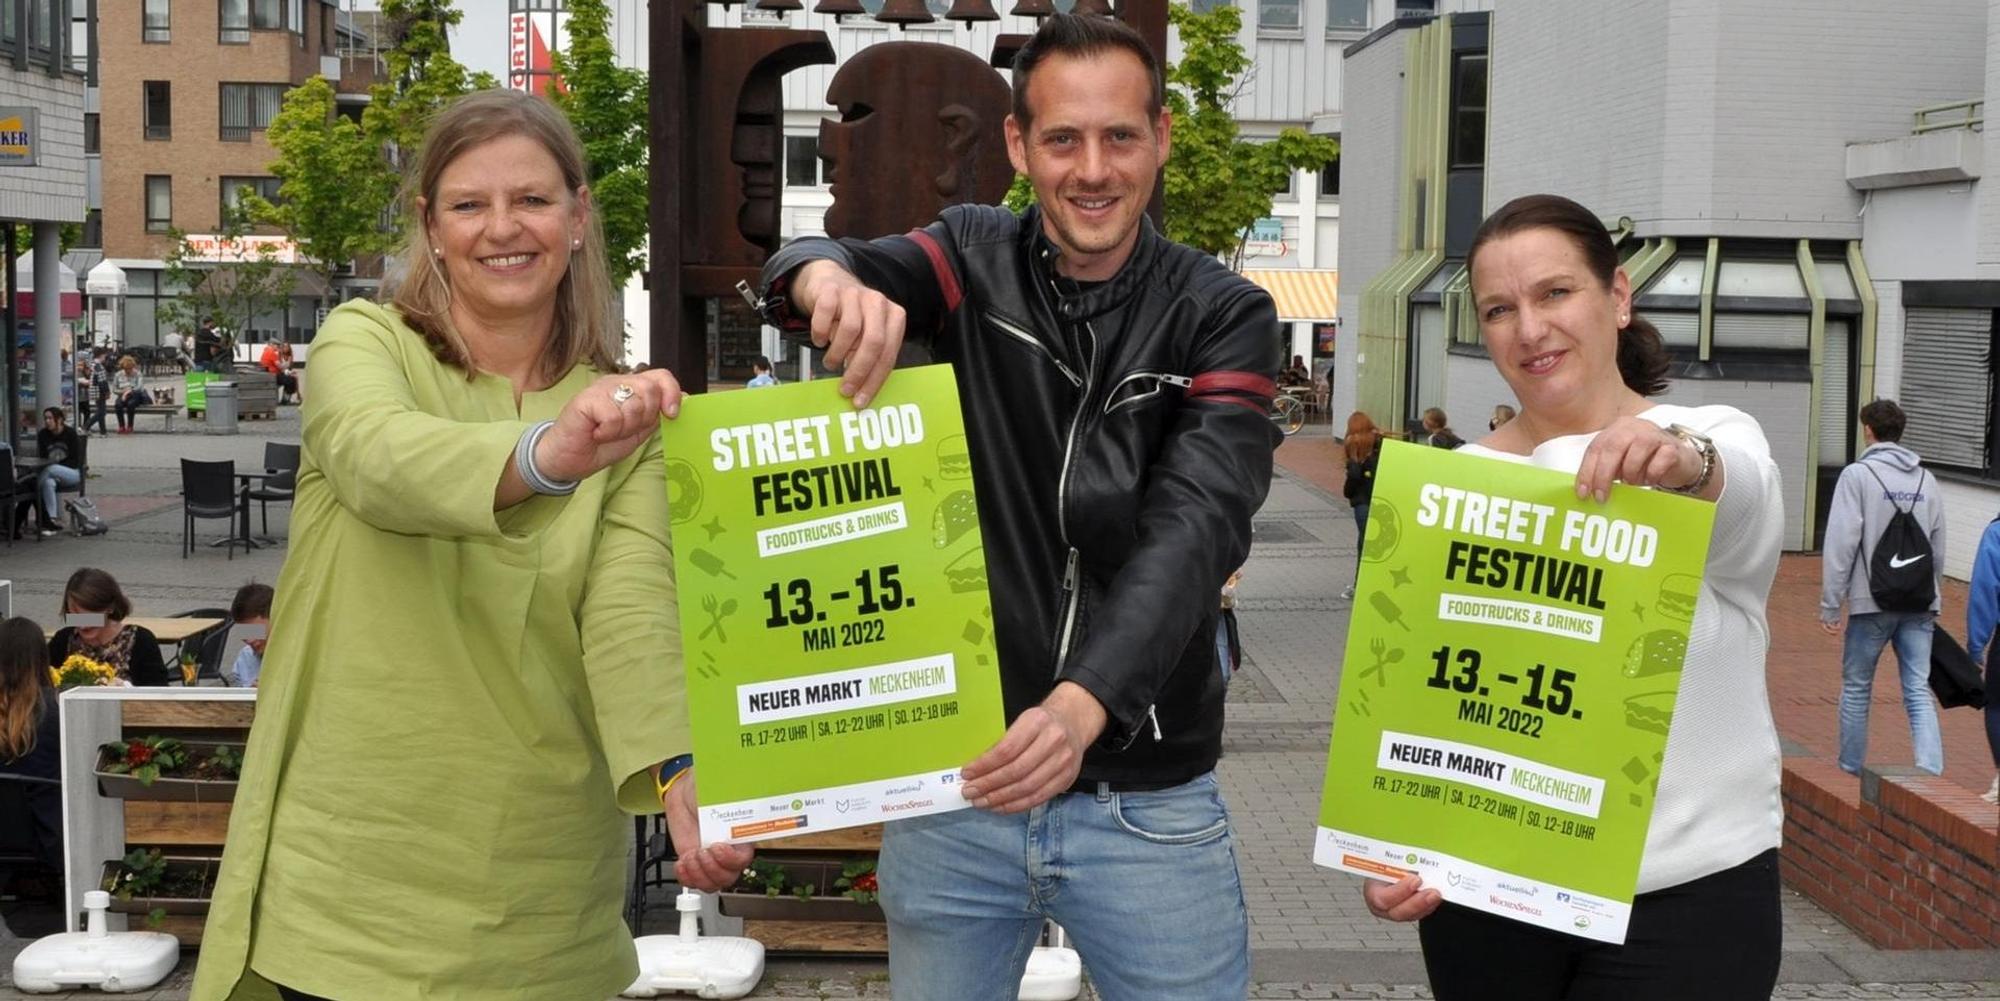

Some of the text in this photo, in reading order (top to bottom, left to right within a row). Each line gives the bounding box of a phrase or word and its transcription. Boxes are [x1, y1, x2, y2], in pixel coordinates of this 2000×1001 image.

[710, 403, 924, 471] STREET FOOD
[752, 457, 902, 517] FESTIVAL
[766, 509, 900, 550] FOODTRUCKS & DRINKS
[1417, 483, 1658, 568] STREET FOOD
[1445, 540, 1606, 610] FESTIVAL
[803, 618, 886, 652] MAI 2022
[1447, 600, 1594, 636] FOODTRUCKS & DRINKS
[749, 665, 946, 713] NEUER MARKT MECKENHEIM
[741, 700, 960, 748] FR. 17-22 UHR SA. 12-22 UHR SO. 12-18 UHR
[1458, 699, 1544, 738] MAI 2022
[1390, 742, 1592, 806] NEUER MARKT MECKENHEIM
[1373, 775, 1596, 841] FR. 17-22 UHR SA. 12-22 UHR SO. 12-18 UHR
